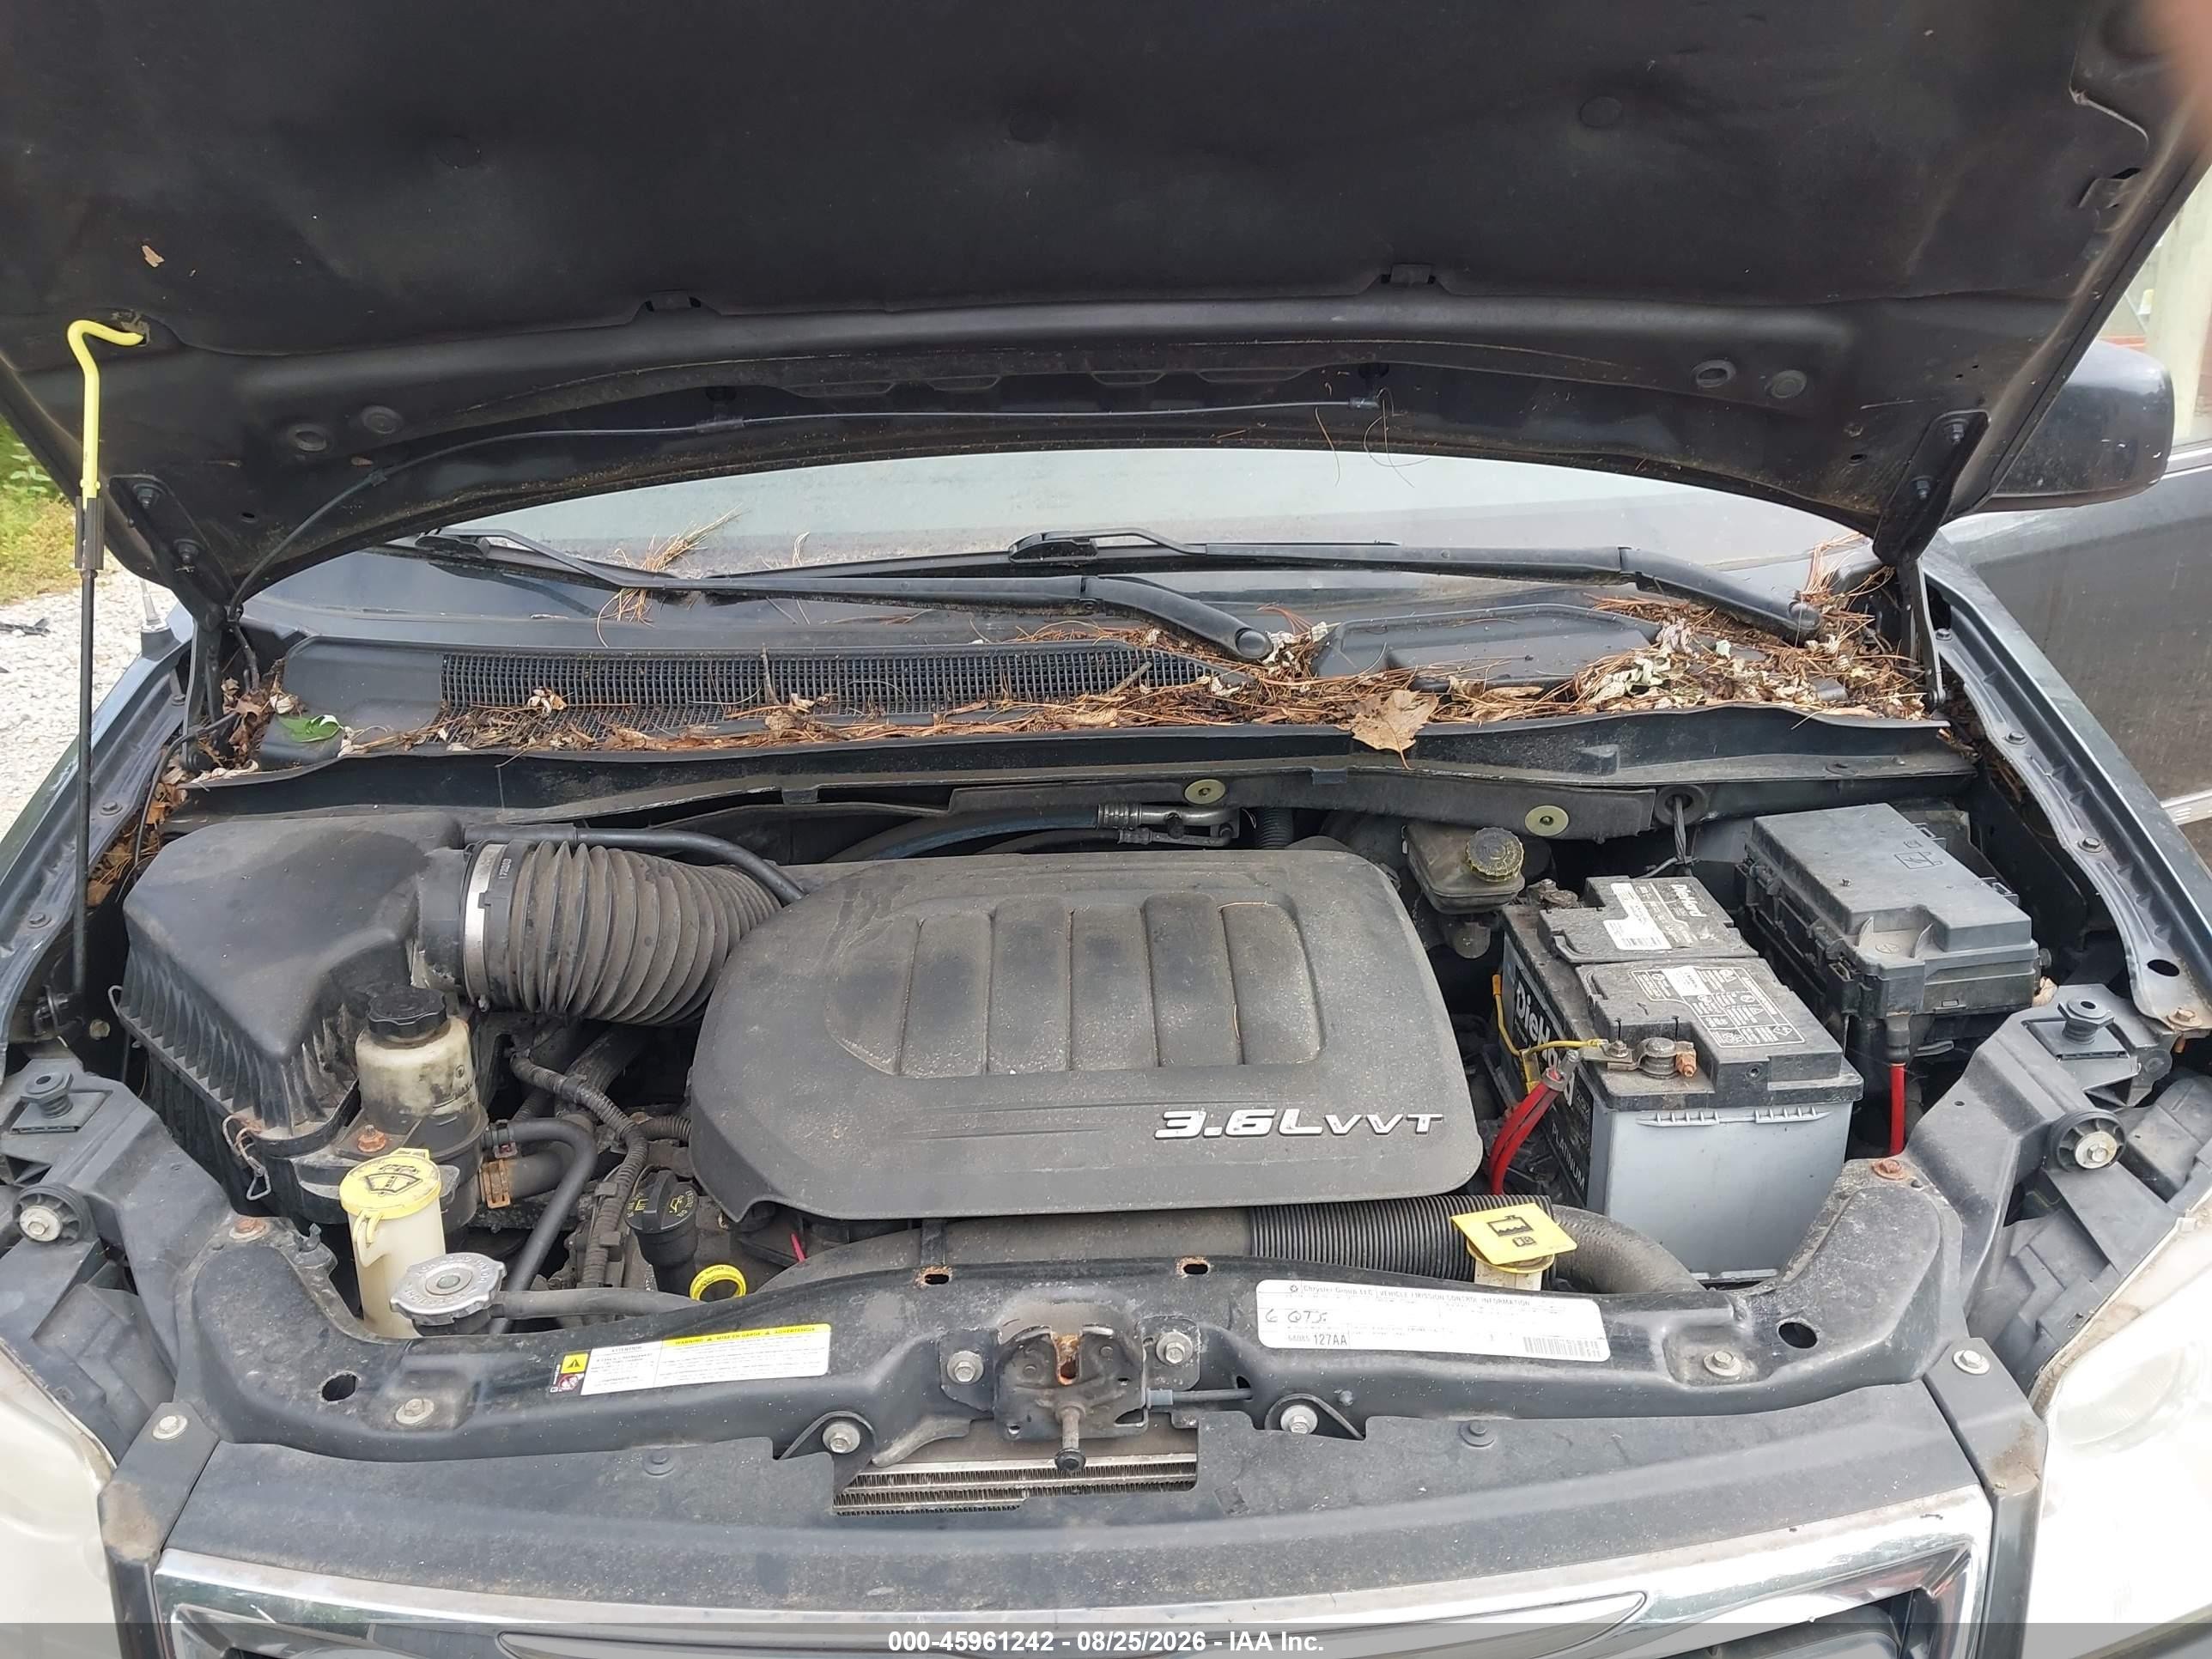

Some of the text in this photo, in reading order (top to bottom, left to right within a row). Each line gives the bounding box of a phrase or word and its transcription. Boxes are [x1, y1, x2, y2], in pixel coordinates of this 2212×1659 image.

[1669, 883, 1707, 917] DieHard
[1551, 1119, 1586, 1192] PLATINUM
[1314, 1334, 1347, 1346] 127AA
